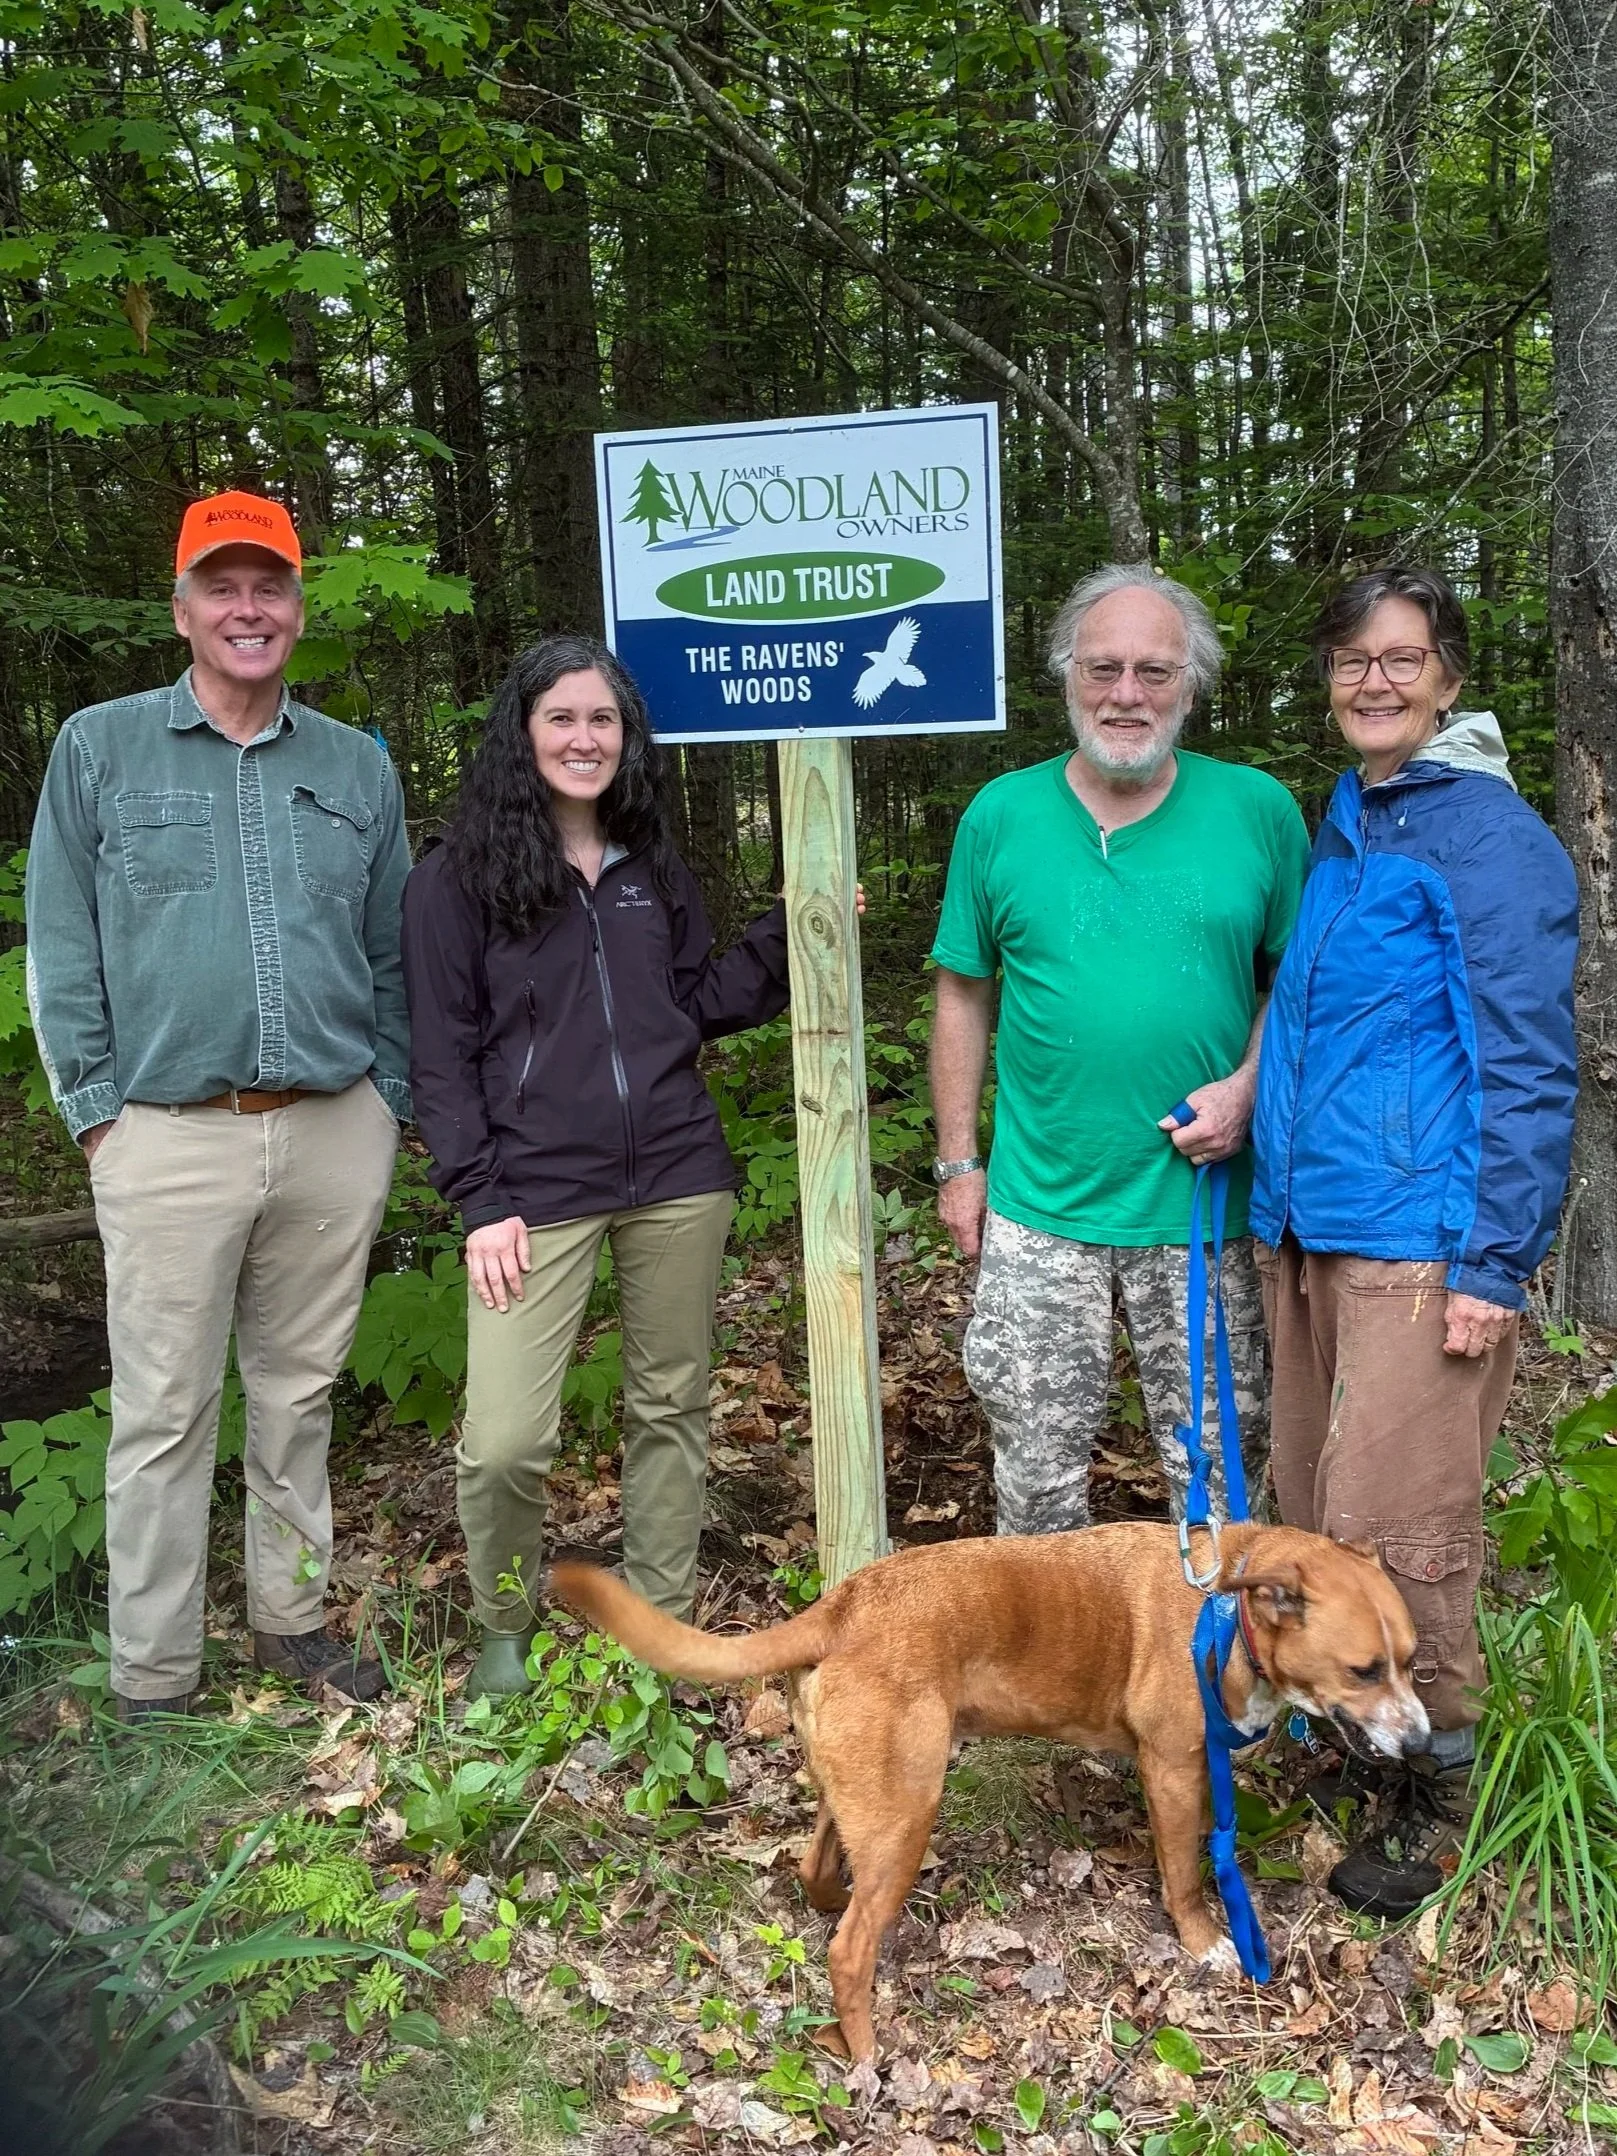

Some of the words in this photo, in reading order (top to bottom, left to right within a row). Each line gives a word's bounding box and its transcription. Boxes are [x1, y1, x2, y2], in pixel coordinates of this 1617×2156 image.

[733, 465, 785, 479] MAINE
[665, 466, 970, 531] WOODLAND
[837, 513, 969, 538] OWNERS
[705, 569, 785, 607] LAND
[793, 563, 892, 600] TRUST
[686, 646, 731, 673] THE
[742, 641, 844, 671] RAVENS'
[721, 676, 811, 705] WOODS
